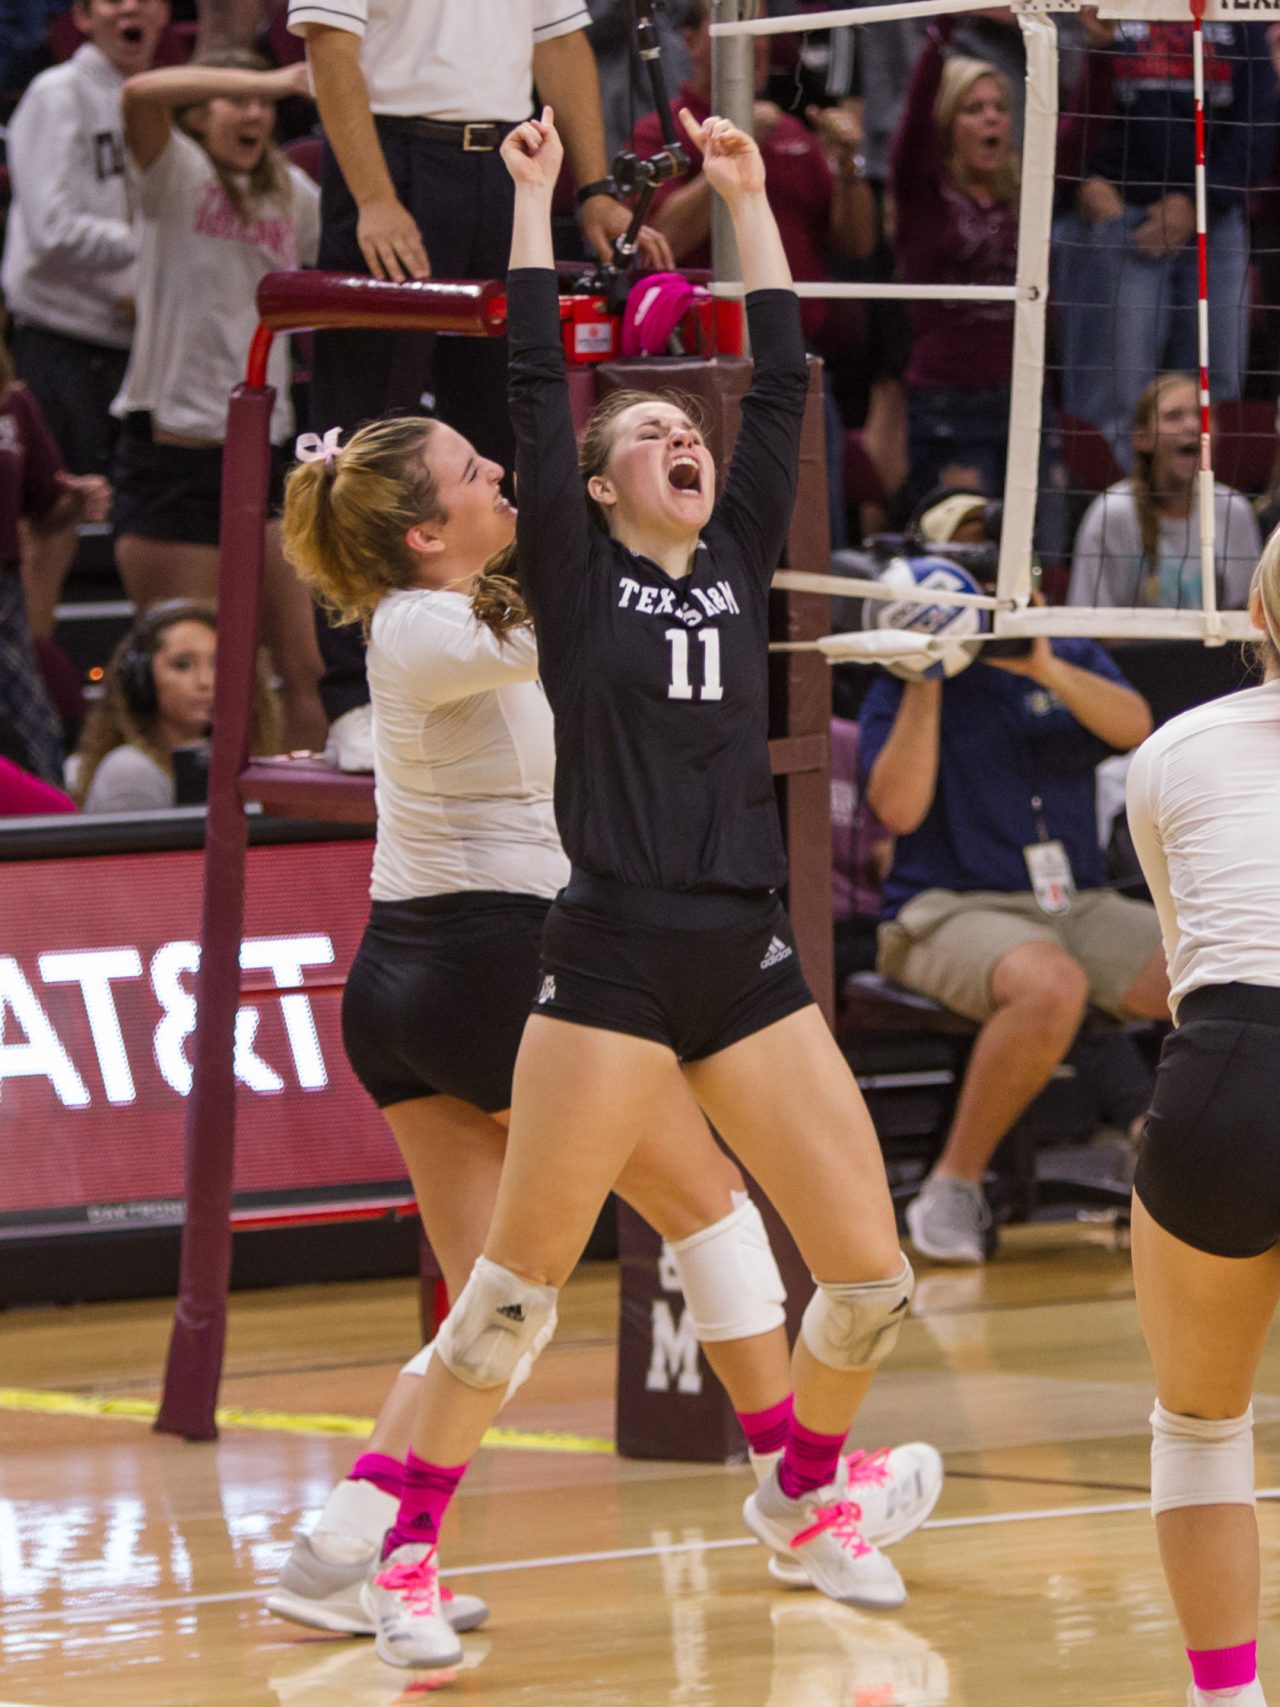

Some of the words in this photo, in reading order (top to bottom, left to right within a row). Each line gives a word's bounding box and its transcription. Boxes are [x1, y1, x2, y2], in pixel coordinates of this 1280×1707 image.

[665, 627, 724, 700] 11
[760, 946, 793, 970] adidas
[0, 934, 334, 1106] AT&T
